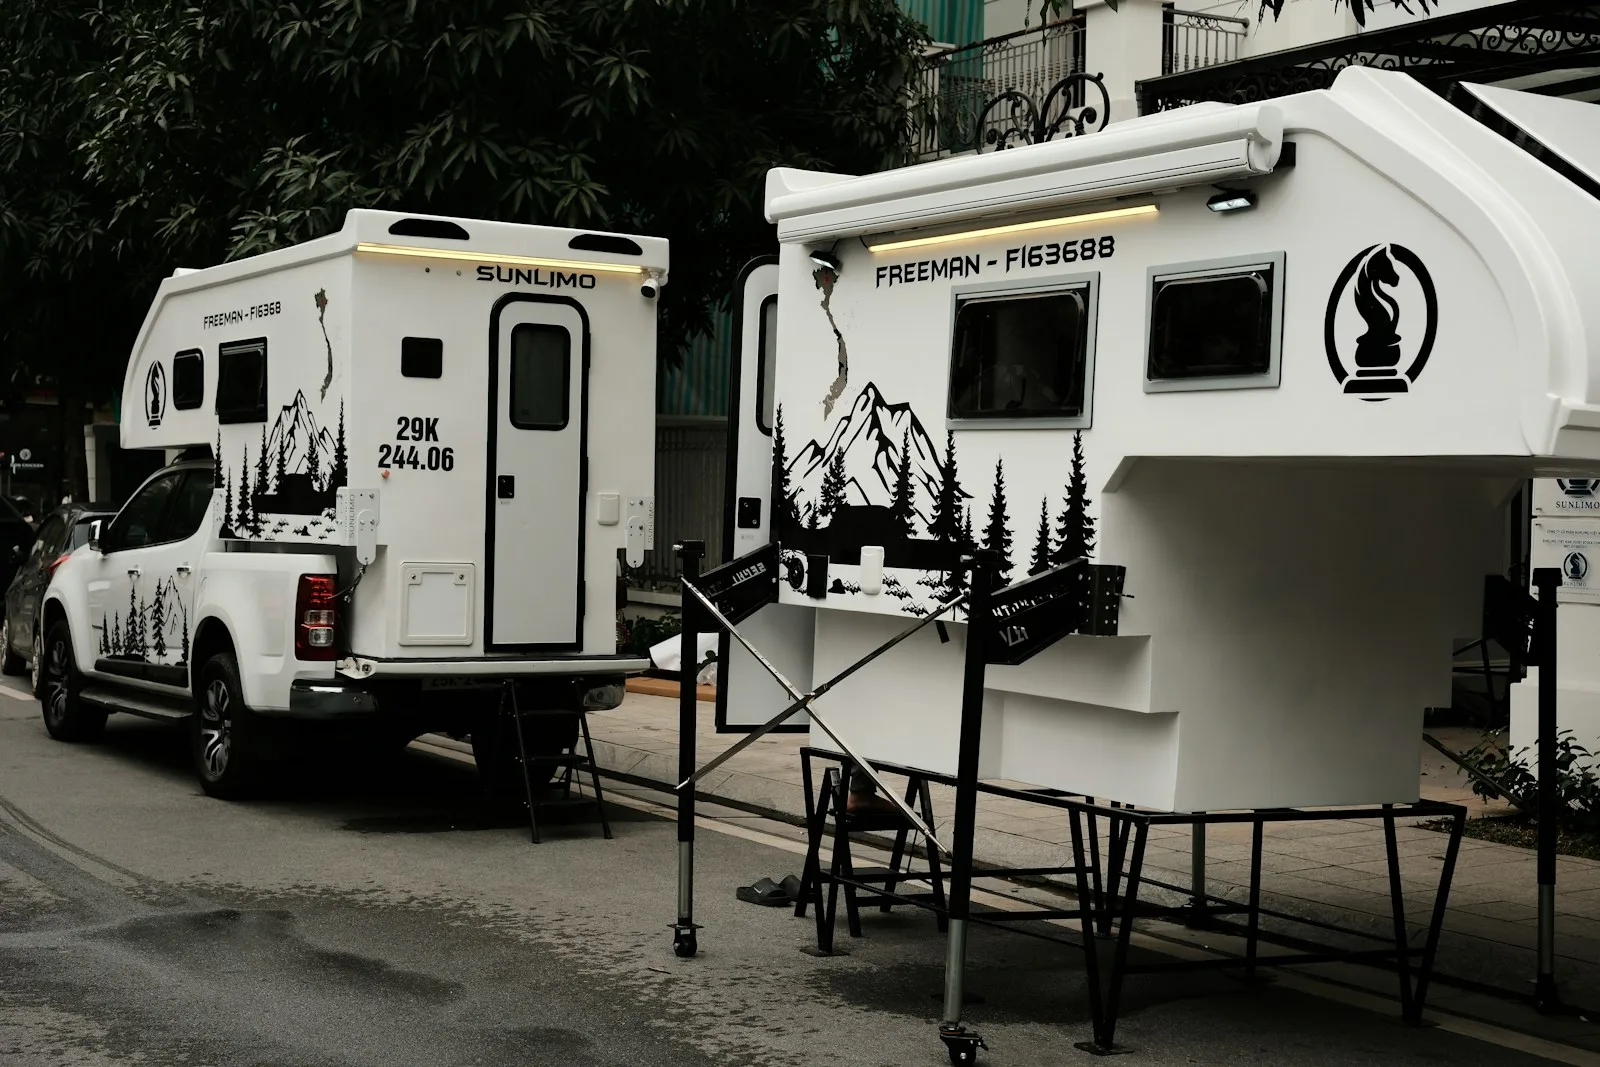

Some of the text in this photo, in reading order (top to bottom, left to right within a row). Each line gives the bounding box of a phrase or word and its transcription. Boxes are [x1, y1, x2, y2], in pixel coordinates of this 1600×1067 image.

[476, 264, 596, 289] SUNLIMO
[876, 254, 980, 289] FREEMAN
[203, 309, 243, 330] FREEMAN
[396, 416, 440, 442] 29K
[378, 443, 454, 472] 244.06
[1556, 501, 1600, 509] SUNLIMO
